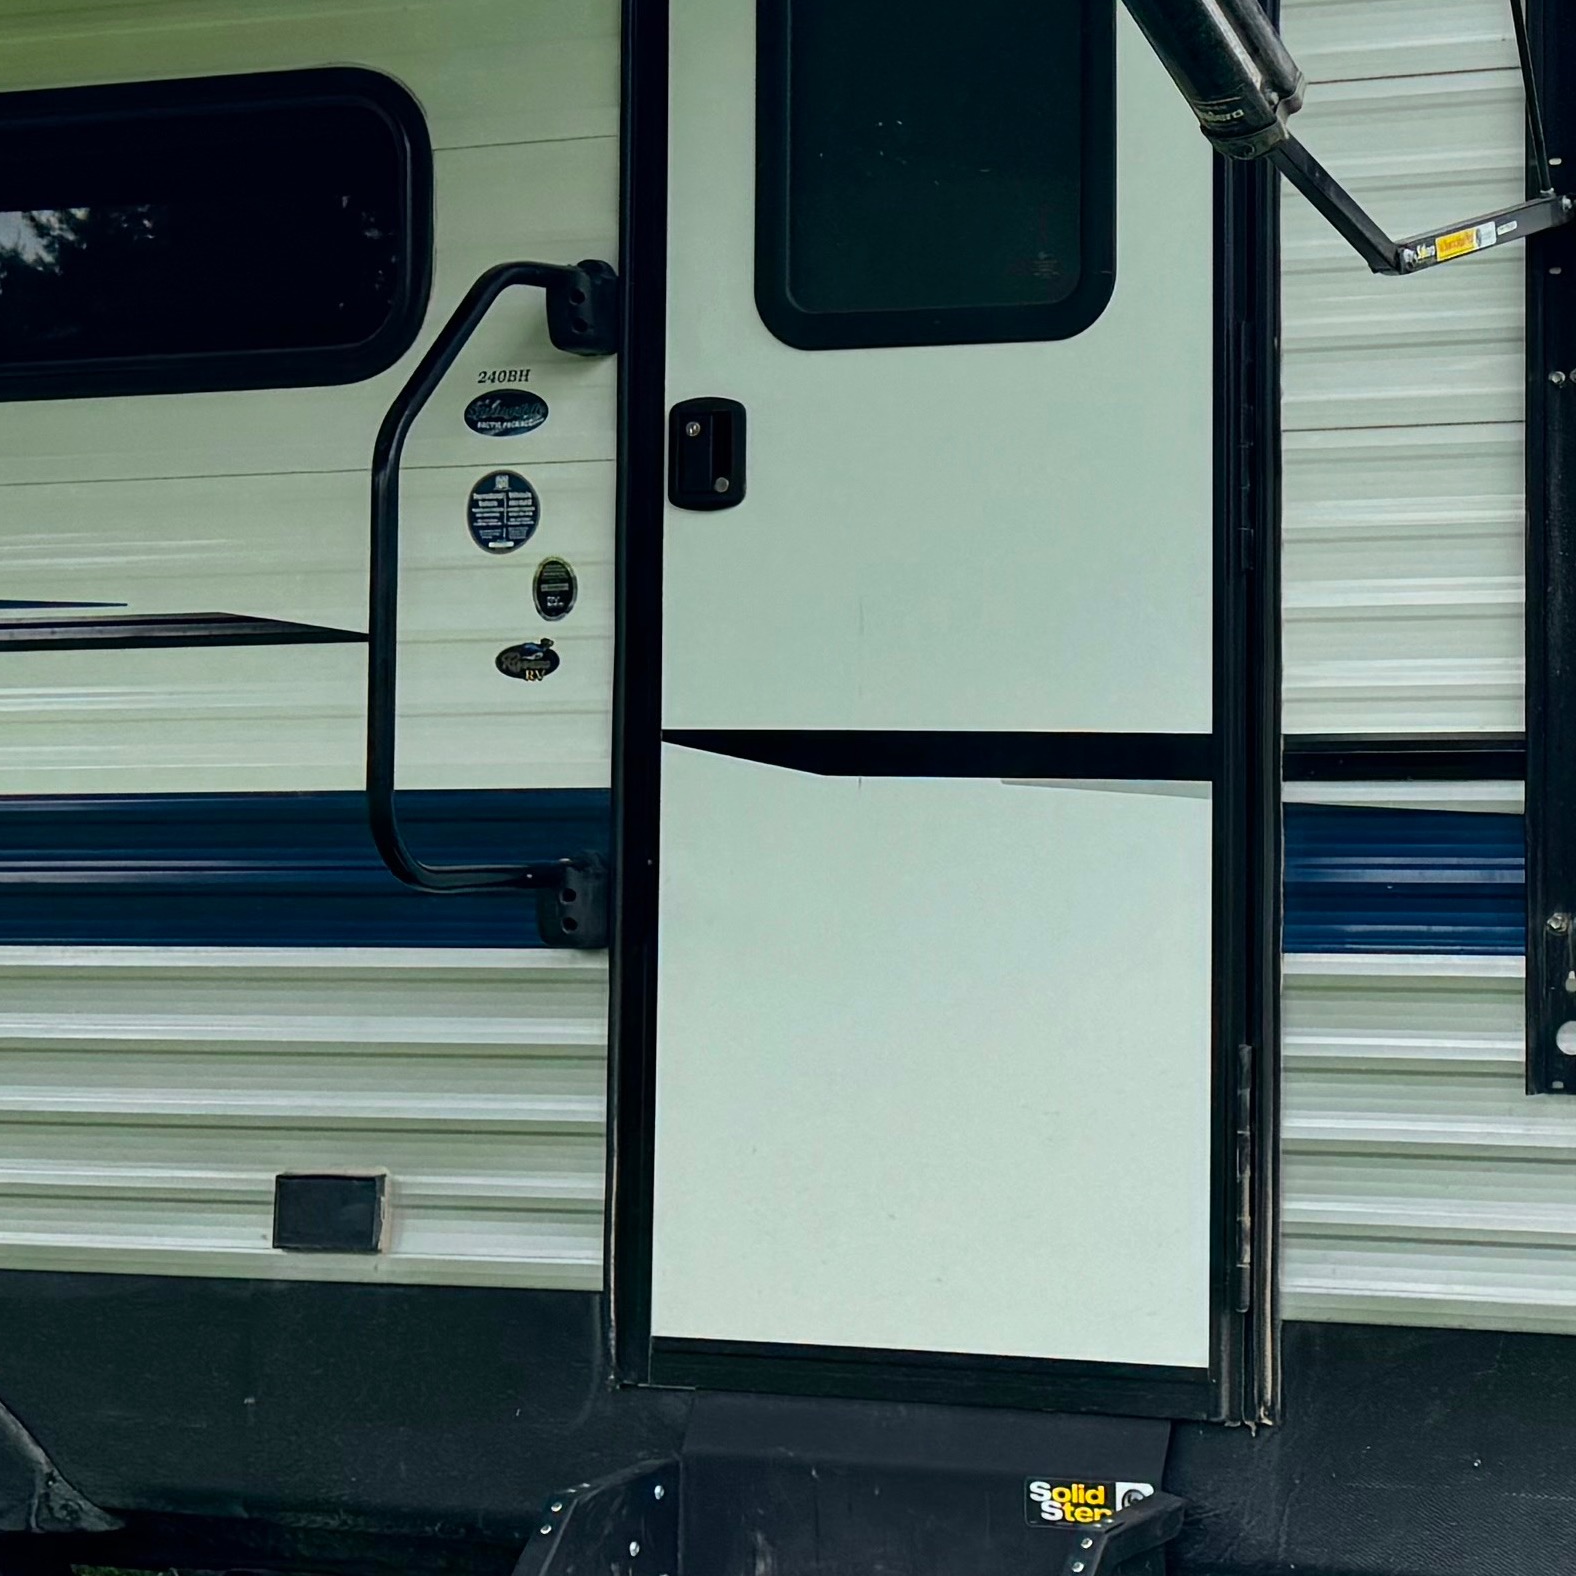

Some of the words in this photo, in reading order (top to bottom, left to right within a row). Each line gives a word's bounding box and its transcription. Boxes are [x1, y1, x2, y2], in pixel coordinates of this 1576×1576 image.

[477, 369, 531, 384] 240BH
[525, 669, 546, 681] RV
[1029, 1481, 1105, 1504] Solid
